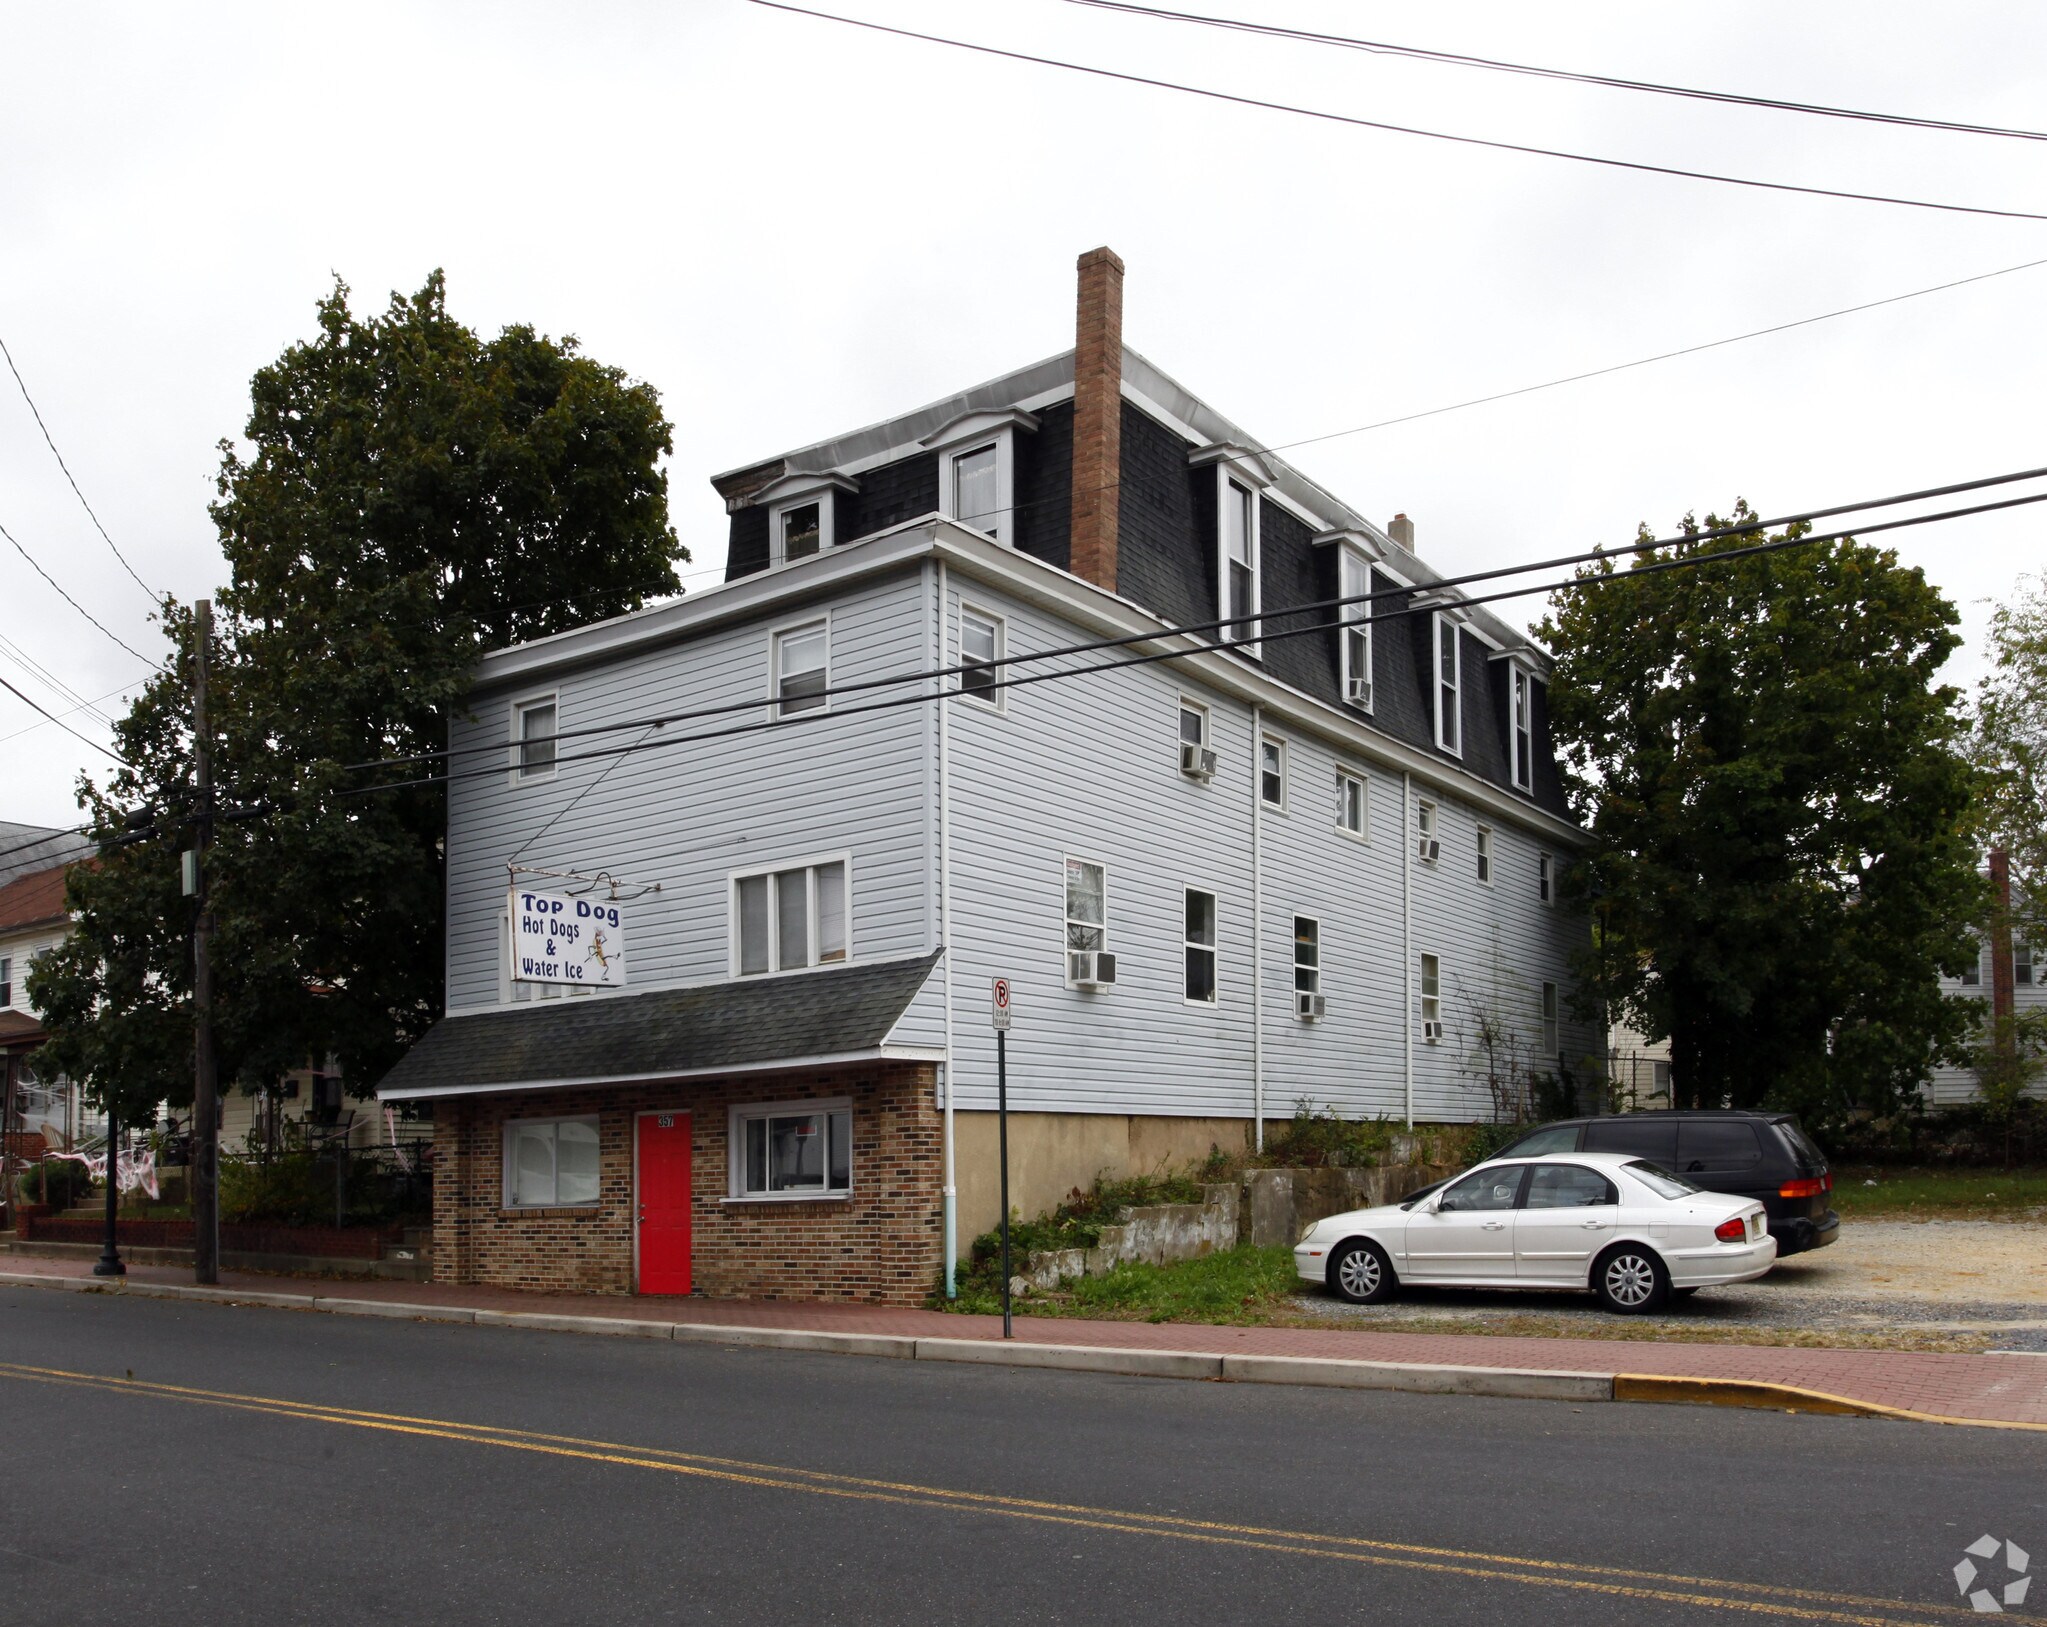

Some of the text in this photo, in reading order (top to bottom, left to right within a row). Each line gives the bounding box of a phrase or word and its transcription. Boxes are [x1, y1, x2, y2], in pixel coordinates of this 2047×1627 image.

[577, 901, 619, 928] Dog
[523, 916, 580, 944] Hot Dogs
[546, 938, 556, 956] &
[522, 958, 583, 979] Water Ice
[658, 1115, 673, 1127] 357
